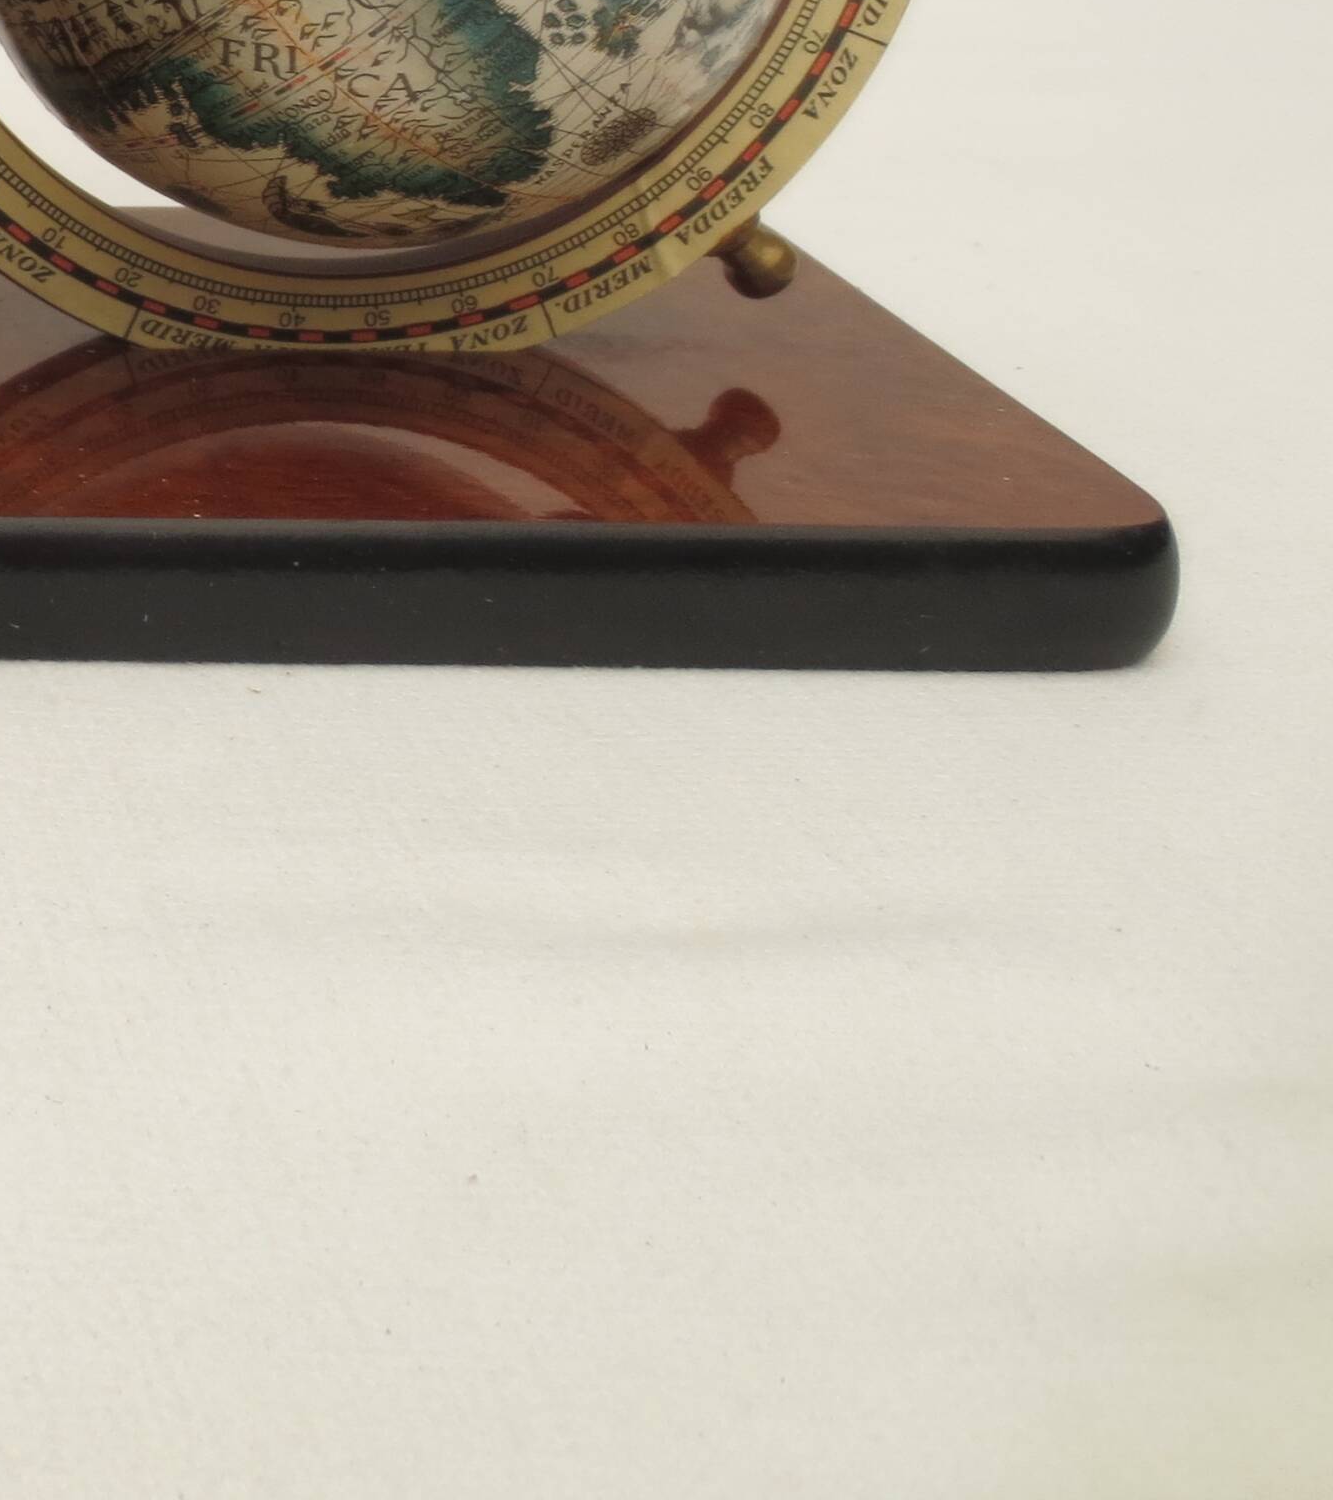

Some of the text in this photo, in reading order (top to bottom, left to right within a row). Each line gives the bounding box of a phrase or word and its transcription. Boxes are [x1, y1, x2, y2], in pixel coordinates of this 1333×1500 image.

[804, 29, 829, 56] 70
[750, 103, 775, 130] 80
[554, 46, 859, 316] ZONA FREDDA MERID.
[686, 166, 713, 192] 90
[41, 226, 67, 250] 10
[613, 223, 640, 247] 80
[114, 266, 144, 287] 20
[532, 265, 559, 288] 70
[193, 295, 221, 314] 30
[451, 295, 477, 314] 60
[279, 311, 306, 327] 40
[364, 311, 391, 327] 50
[448, 315, 529, 351] ZONA
